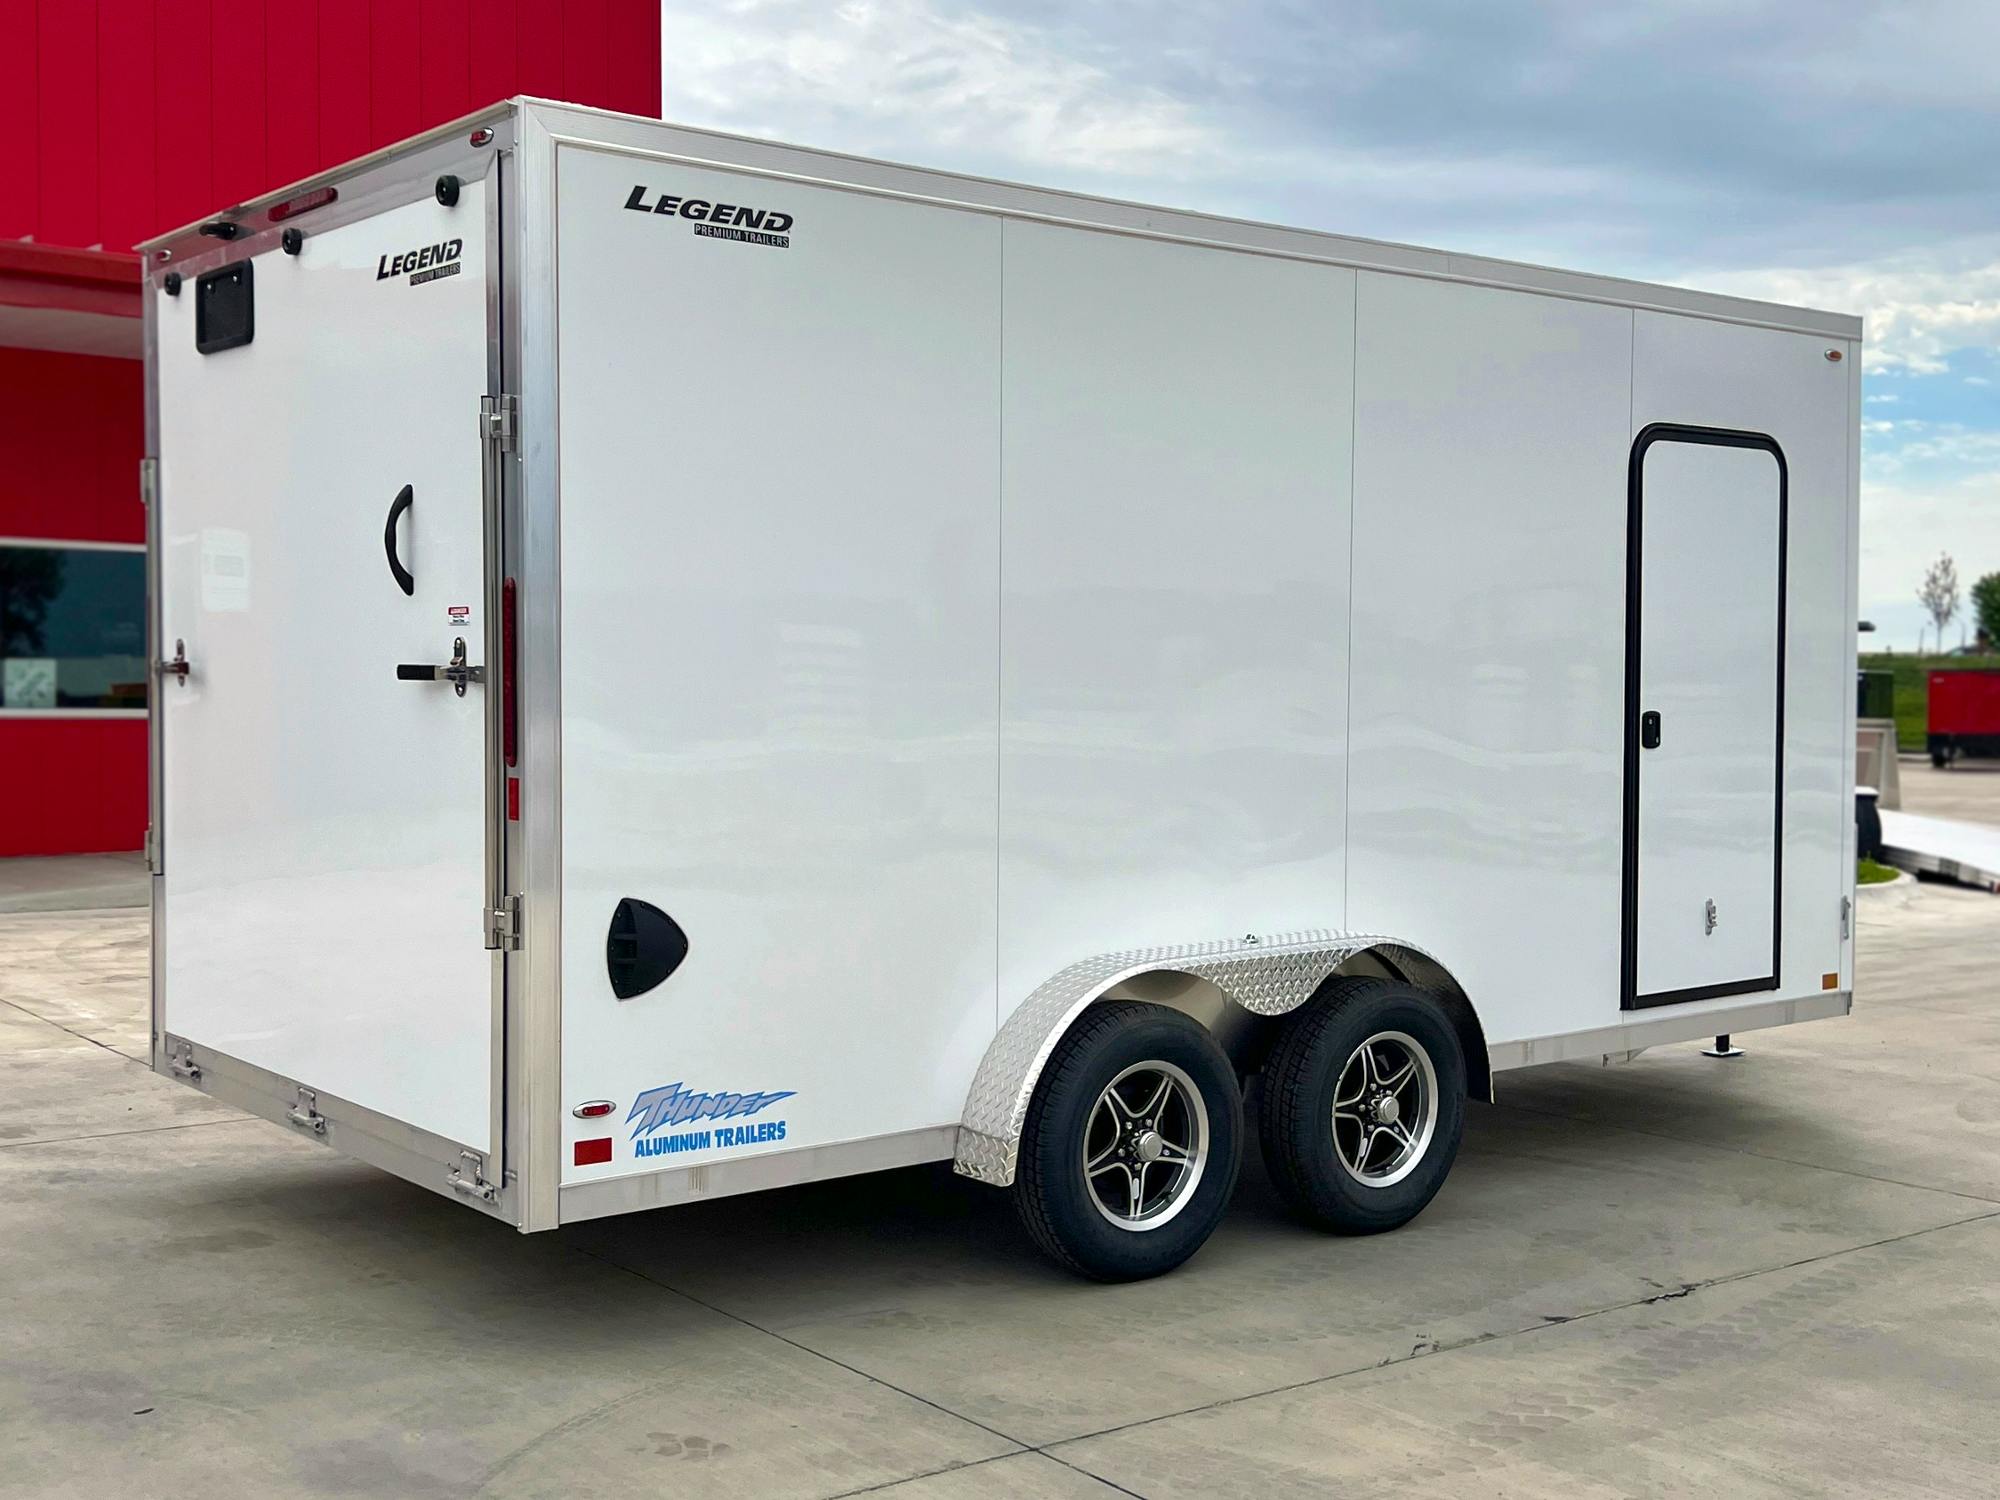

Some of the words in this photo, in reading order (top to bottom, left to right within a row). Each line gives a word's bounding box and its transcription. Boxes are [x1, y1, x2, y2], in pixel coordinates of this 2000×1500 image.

[624, 185, 793, 232] LEGEND
[695, 225, 741, 240] PREMIUM
[744, 232, 790, 248] TRAILERS
[376, 239, 463, 280] LEGEND
[634, 1132, 711, 1158] ALUMINUM
[714, 1120, 786, 1148] TRAILERS
